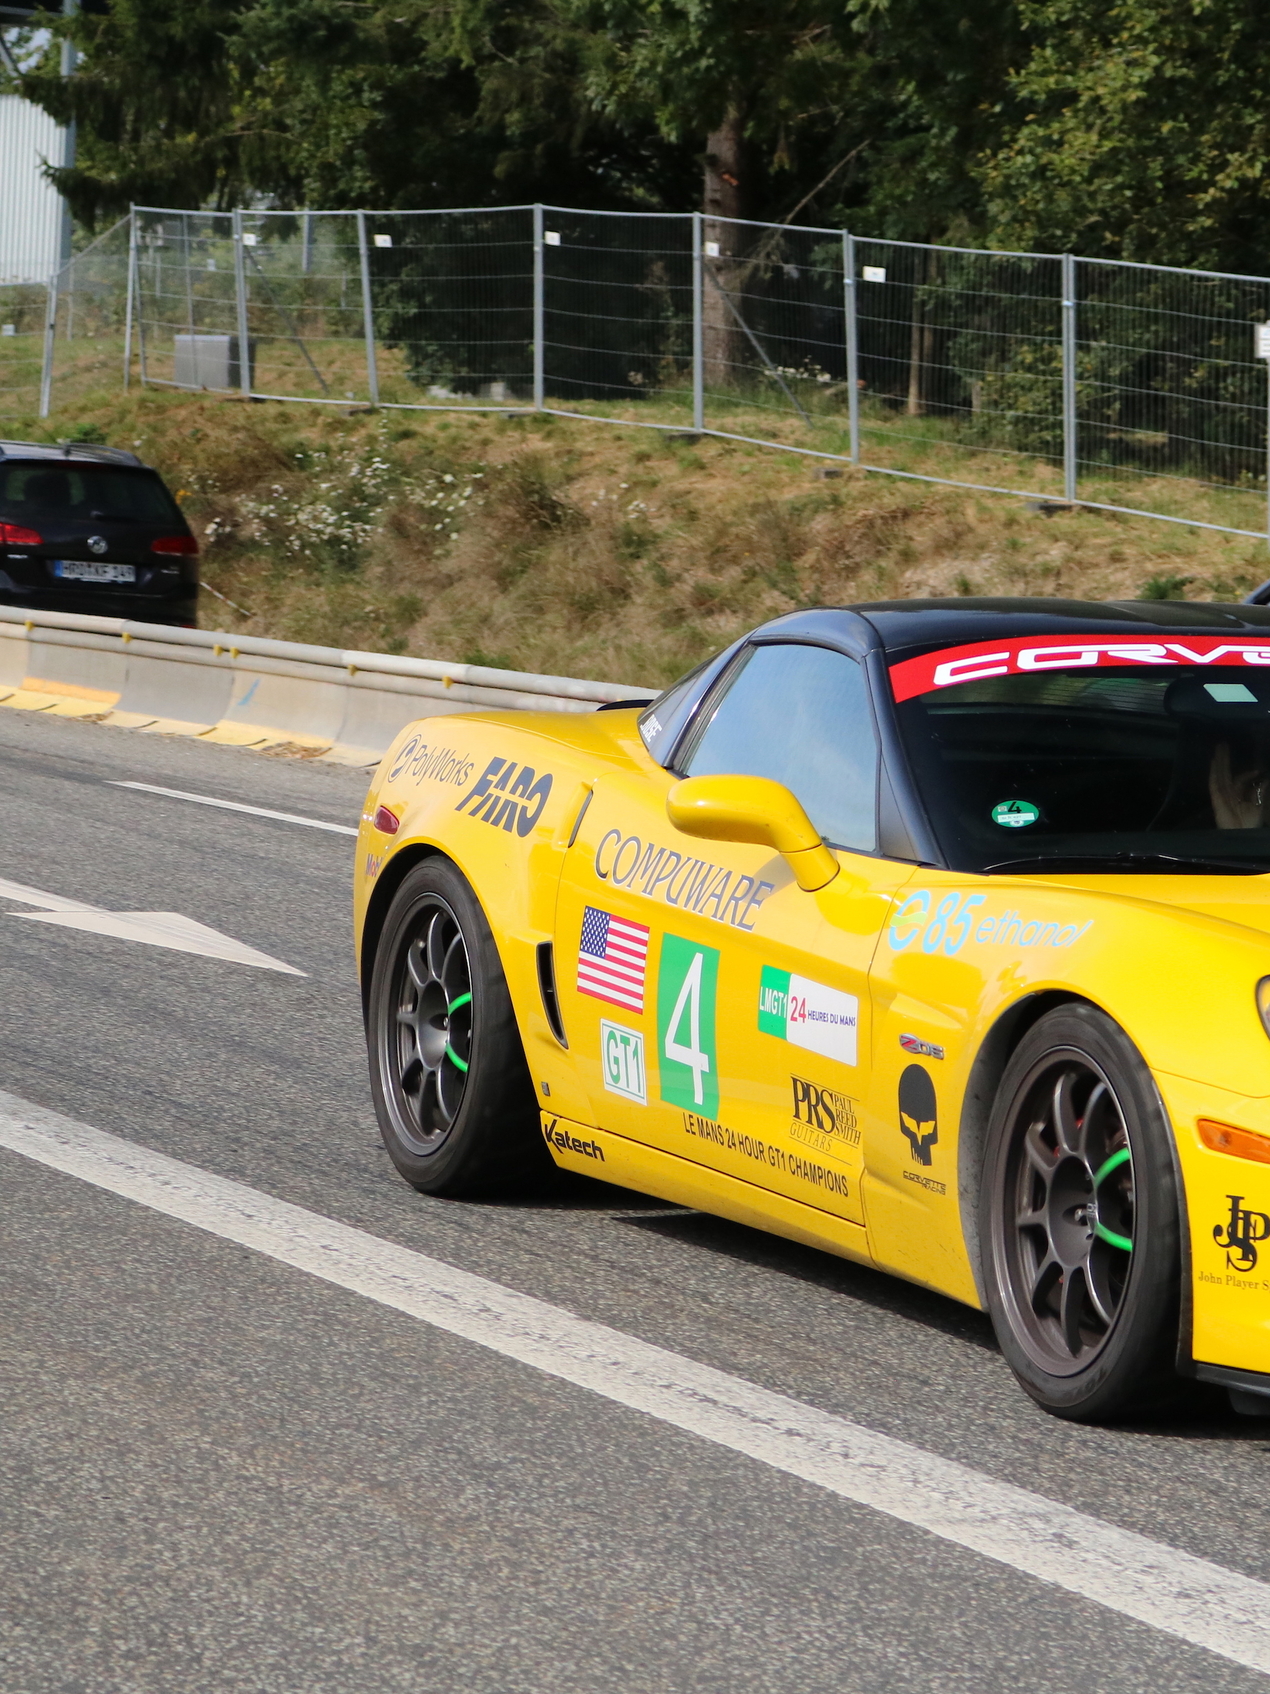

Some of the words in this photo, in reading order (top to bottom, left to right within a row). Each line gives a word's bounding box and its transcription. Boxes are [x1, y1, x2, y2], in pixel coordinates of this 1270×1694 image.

[404, 744, 474, 786] PolyWorks
[454, 756, 553, 838] FARO
[595, 828, 776, 932] COMPUWARE
[975, 910, 1095, 948] ethanol
[759, 985, 788, 1018] LMGT1
[789, 996, 807, 1023] 24
[807, 1009, 829, 1023] HEURES
[830, 1013, 839, 1025] DU
[839, 1015, 856, 1027] MANS
[664, 951, 710, 1106] 4
[606, 1028, 643, 1094] GT1
[790, 1075, 836, 1134] PRS
[833, 1093, 854, 1114] PAUL
[835, 1108, 857, 1129] REED
[545, 1119, 605, 1162] Katech
[790, 1122, 833, 1152] GUITARS
[834, 1122, 861, 1146] SMITH
[683, 1112, 697, 1136] LE
[697, 1117, 725, 1147] MANS
[725, 1127, 737, 1152] 24
[737, 1132, 767, 1164] HOUR
[767, 1145, 787, 1172] GT1
[788, 1153, 849, 1198] CHAMPIONS
[1198, 1271, 1223, 1285] John
[1225, 1274, 1260, 1290] Player
